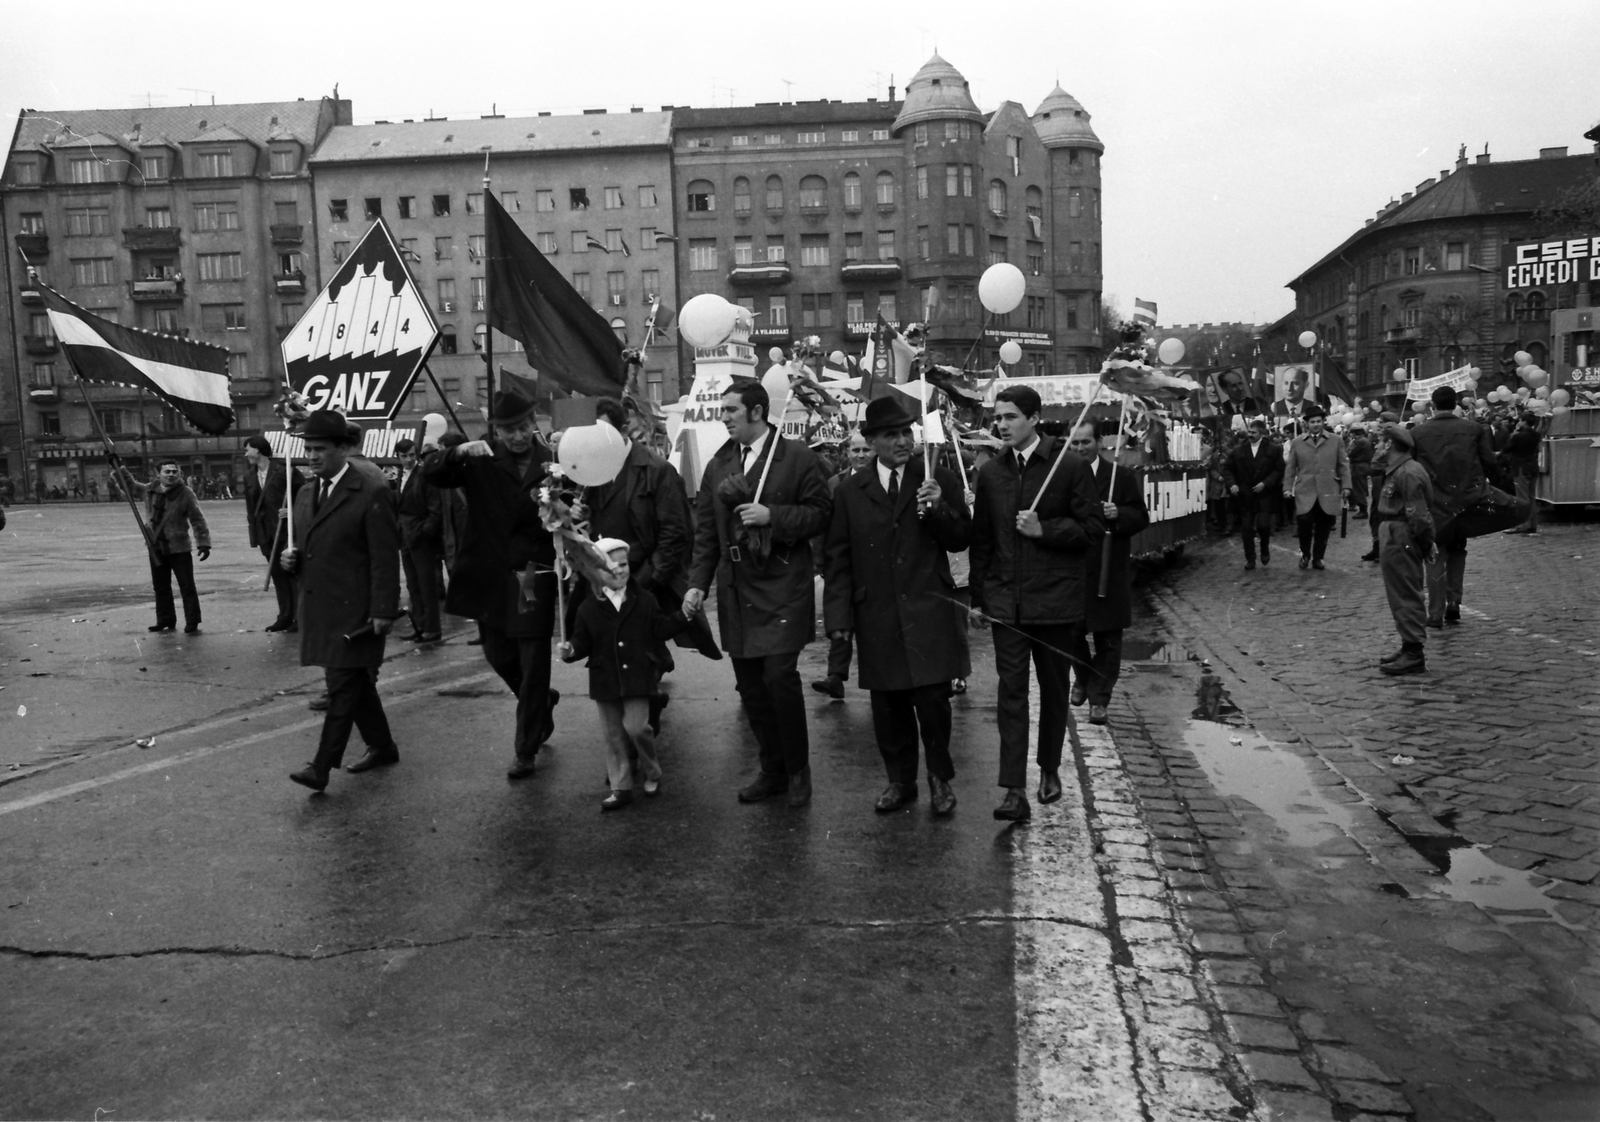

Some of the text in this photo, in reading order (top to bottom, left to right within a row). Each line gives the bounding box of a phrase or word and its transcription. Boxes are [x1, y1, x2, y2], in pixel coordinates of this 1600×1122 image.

[1507, 259, 1578, 289] EGYEDI
[302, 370, 391, 412] GANZ
[696, 389, 723, 402] ÉLJE
[683, 404, 723, 423] MÁJU
